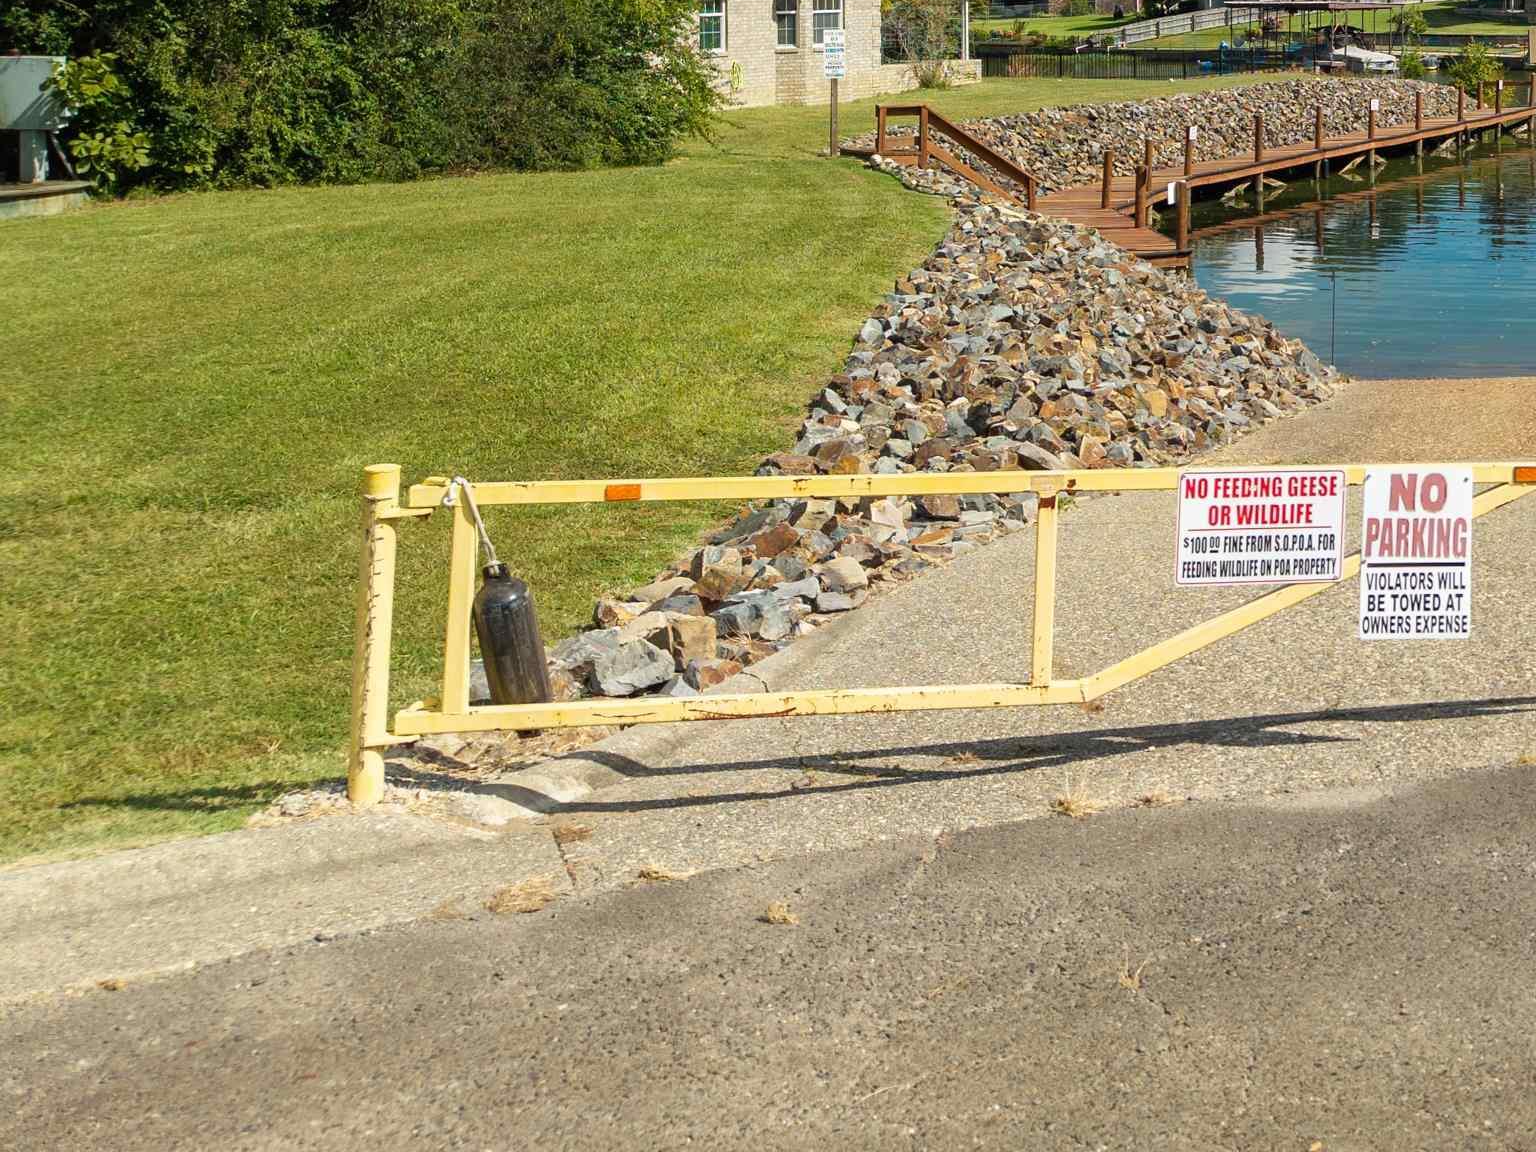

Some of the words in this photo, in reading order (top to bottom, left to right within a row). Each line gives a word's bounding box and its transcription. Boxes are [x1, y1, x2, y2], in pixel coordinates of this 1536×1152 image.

[1184, 478, 1208, 498] NO
[1214, 477, 1282, 498] FEEDING
[1288, 476, 1338, 496] GEESE
[1389, 473, 1447, 512] NO
[1208, 505, 1230, 526] OR
[1236, 504, 1313, 525] WILDLIFE
[1224, 536, 1243, 552] FINE
[1246, 535, 1272, 552] FROM
[1318, 534, 1336, 550] FOR
[1364, 517, 1468, 558] PARKING
[1182, 560, 1216, 578] FEEDING
[1220, 559, 1258, 578] WILDLIFE
[1260, 558, 1272, 576] ON
[1274, 558, 1290, 576] POA
[1293, 558, 1336, 575] PROPERTY
[1366, 572, 1434, 590] VIOLATORS
[1438, 572, 1466, 589] WILL
[1368, 594, 1386, 612] BE
[1391, 594, 1441, 612] TOWED
[1446, 594, 1464, 612] AT
[1362, 616, 1411, 634] OWNERS
[1416, 616, 1468, 632] EXPENSE
